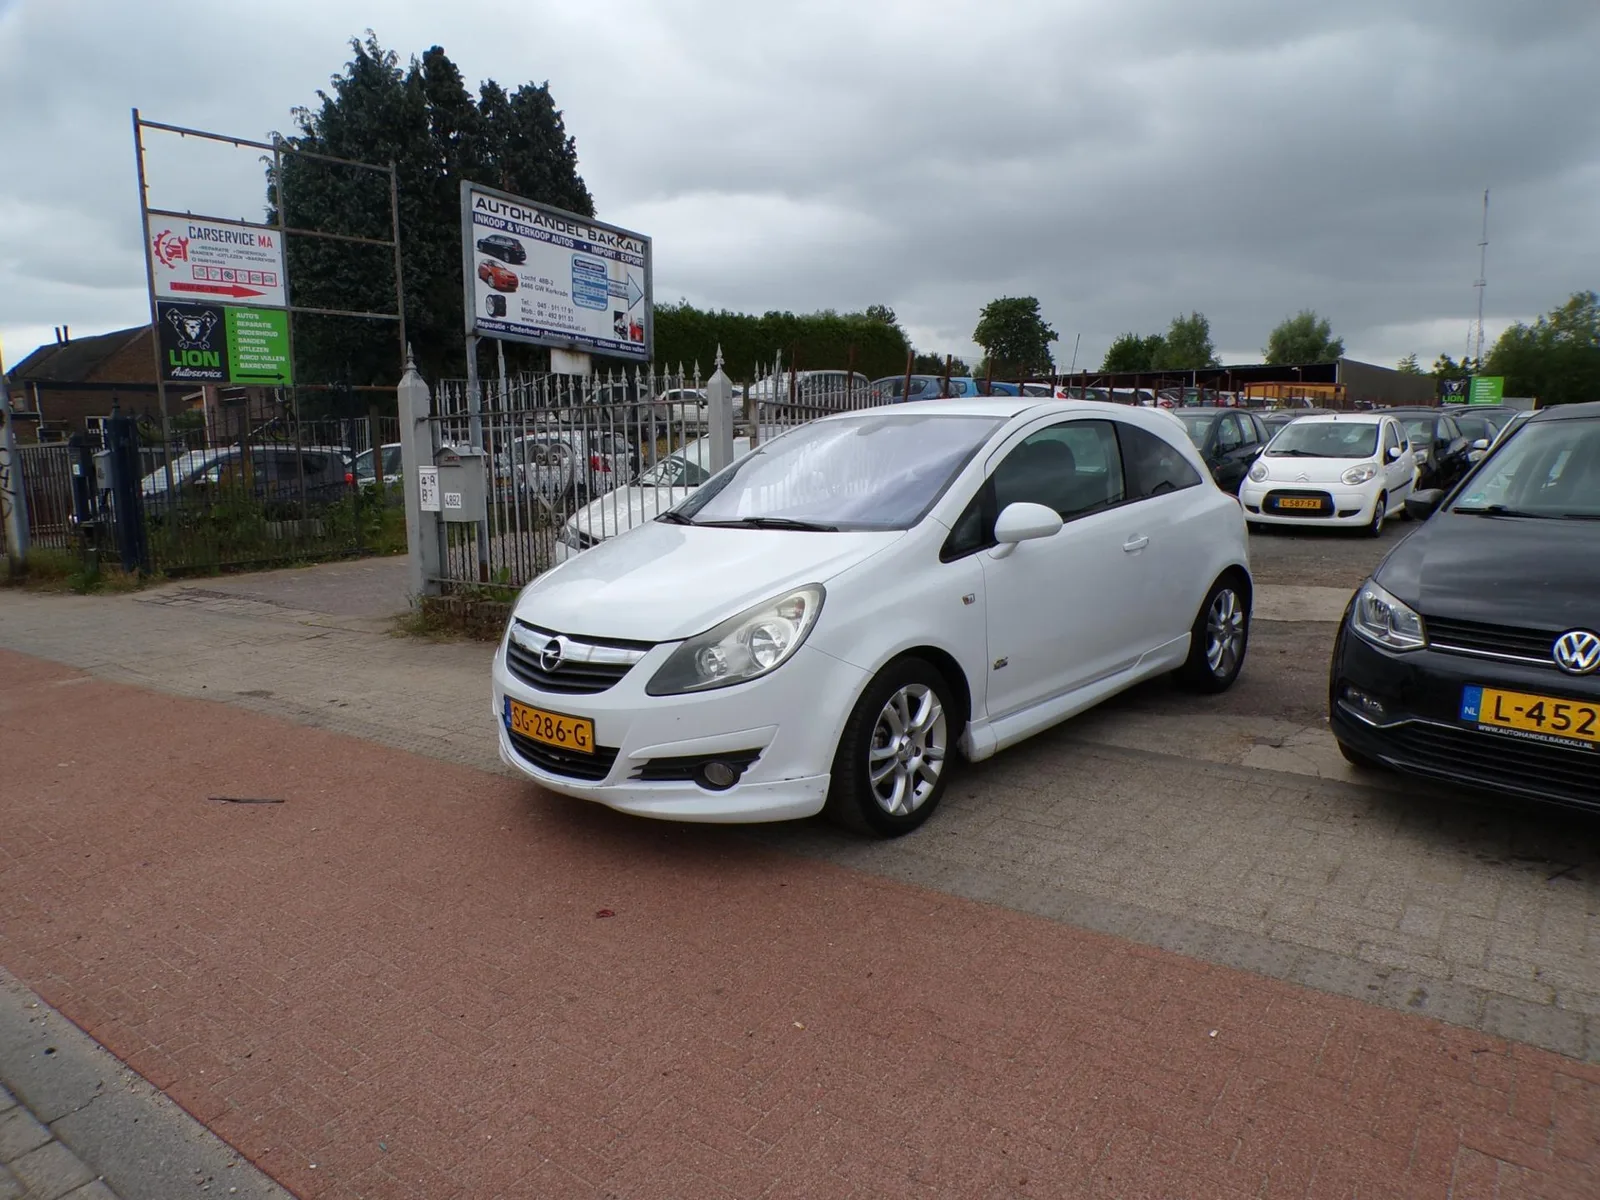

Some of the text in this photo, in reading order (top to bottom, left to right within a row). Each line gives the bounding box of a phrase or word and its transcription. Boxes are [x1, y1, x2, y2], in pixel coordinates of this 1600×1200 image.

[476, 197, 644, 254] AUTOHANDEL BAKKALI
[188, 226, 273, 248] CARSERVICE MA
[475, 214, 644, 267] INKOOP & VERKOOP AUTOS IMPORT EXPORT
[477, 319, 505, 330] Reparatie
[510, 325, 540, 335] Onderhoud
[169, 349, 220, 367] LION
[171, 366, 222, 378] Autoservice
[1464, 706, 1477, 716] NL
[1494, 695, 1596, 736] L-452
[513, 706, 586, 746] SG-286-G
